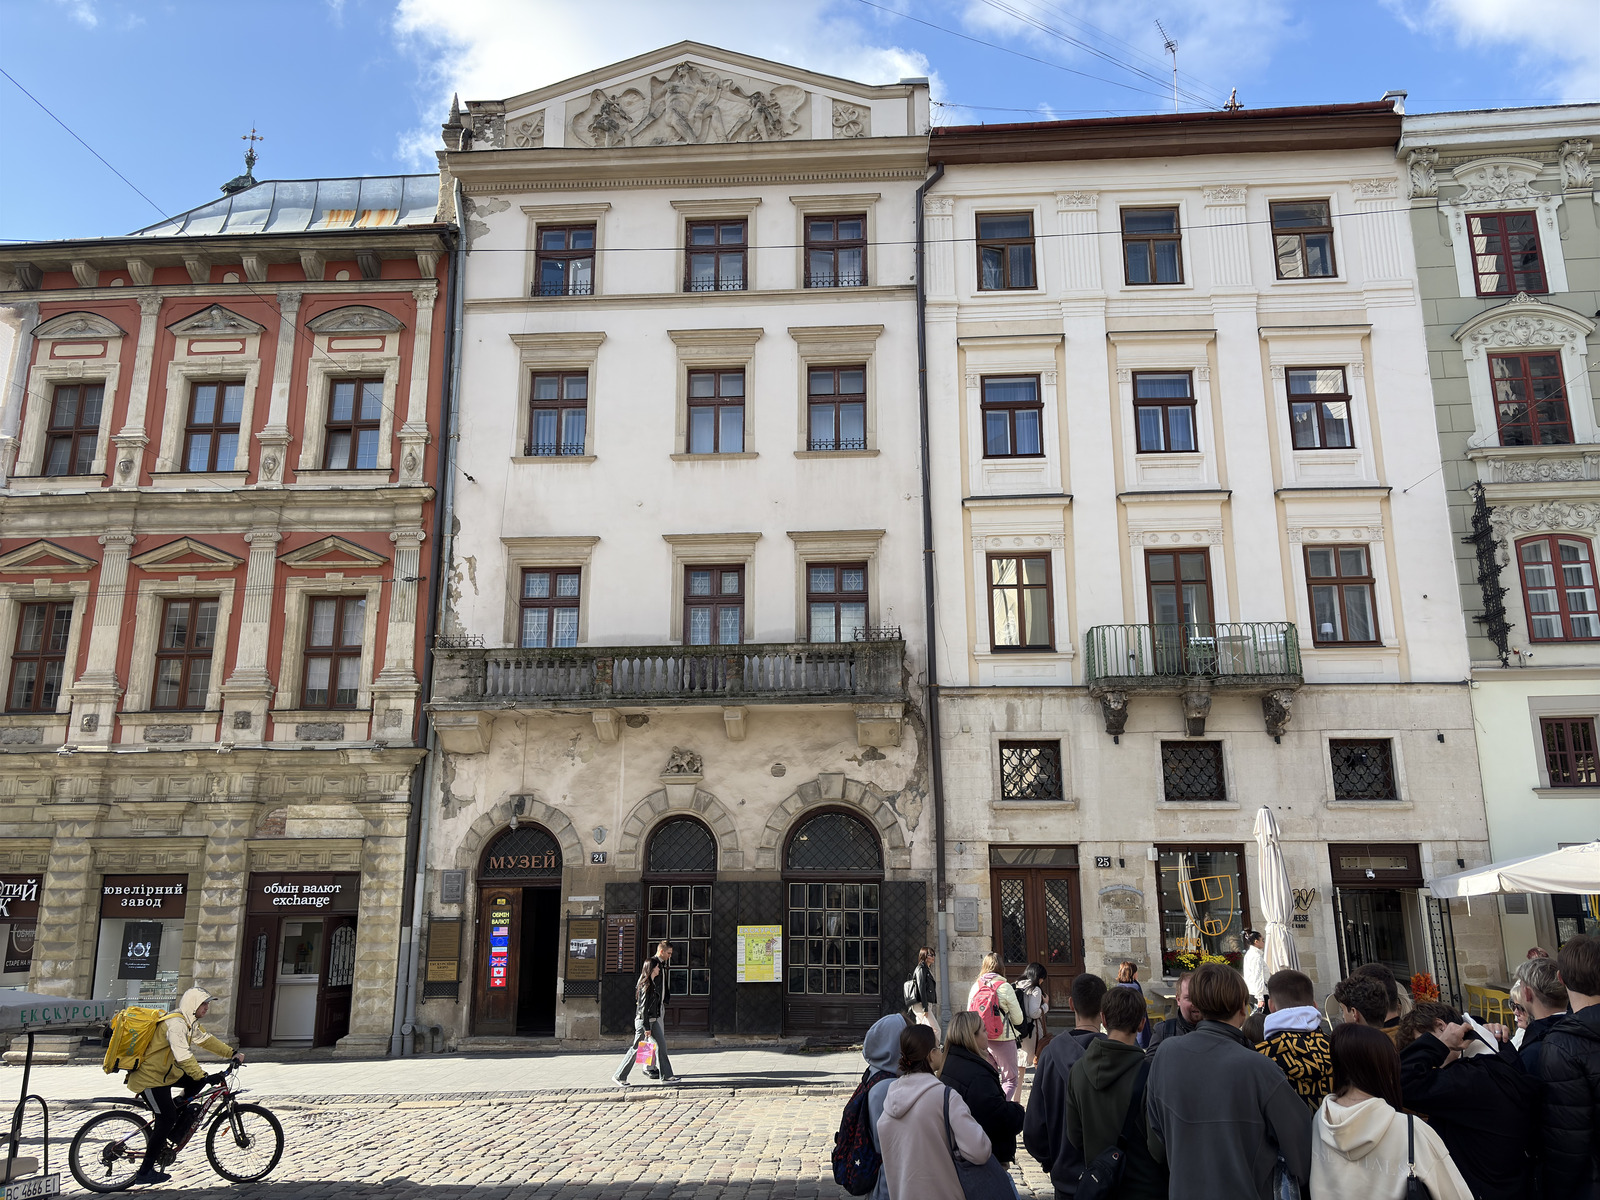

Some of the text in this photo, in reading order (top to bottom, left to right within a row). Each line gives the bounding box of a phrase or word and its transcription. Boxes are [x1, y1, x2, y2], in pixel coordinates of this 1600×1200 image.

[489, 850, 556, 869] МУЗЕЙ
[593, 853, 603, 862] 24
[1097, 857, 1110, 867] 25
[103, 883, 183, 896] ювелірний
[263, 882, 341, 894] обмін валют
[120, 898, 162, 908] завод
[272, 894, 330, 908] exchange
[20, 1004, 105, 1023] ЕКСКУРСІЇ
[21, 1180, 43, 1198] 4666
